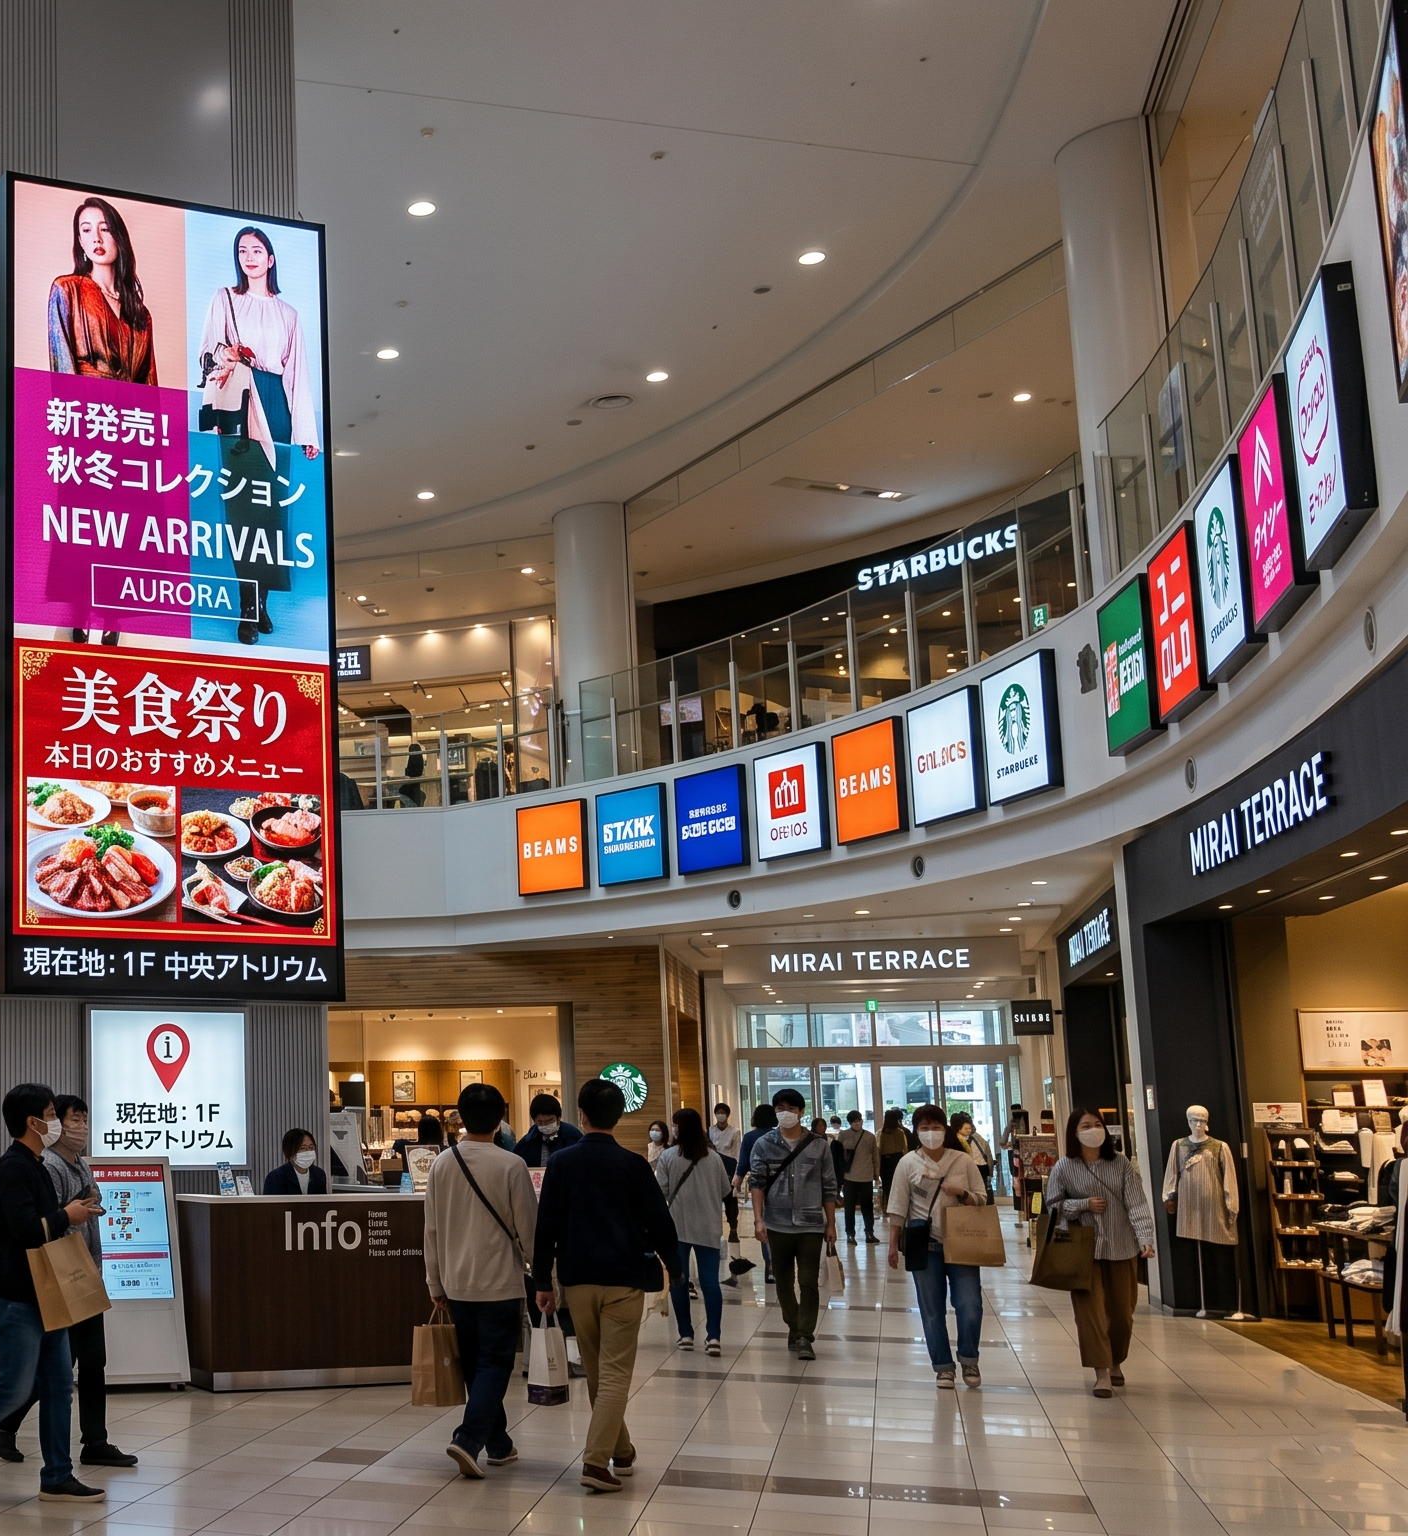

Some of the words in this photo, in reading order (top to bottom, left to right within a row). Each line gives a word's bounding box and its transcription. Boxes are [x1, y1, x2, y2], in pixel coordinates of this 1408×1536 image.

[46, 445, 306, 508] 秋冬コレクション
[42, 504, 129, 549] NEW
[139, 515, 315, 570] ARRIVALS
[857, 523, 1019, 592] STARBUCKS
[119, 576, 232, 610] AURORA
[61, 666, 288, 746] 美食祭り
[44, 740, 304, 779] 本日のおすすめメニュー
[839, 764, 892, 799] BEAMS
[1189, 808, 1239, 876] MIRAI
[1240, 751, 1328, 850] TERRACE
[523, 836, 578, 859] BEAMS
[165, 951, 328, 983] 中央アトリウム
[770, 952, 842, 973] MIRAI
[852, 948, 970, 971] TERRACE
[104, 1129, 233, 1151] 中央アトリウム
[285, 1210, 362, 1251] Info
